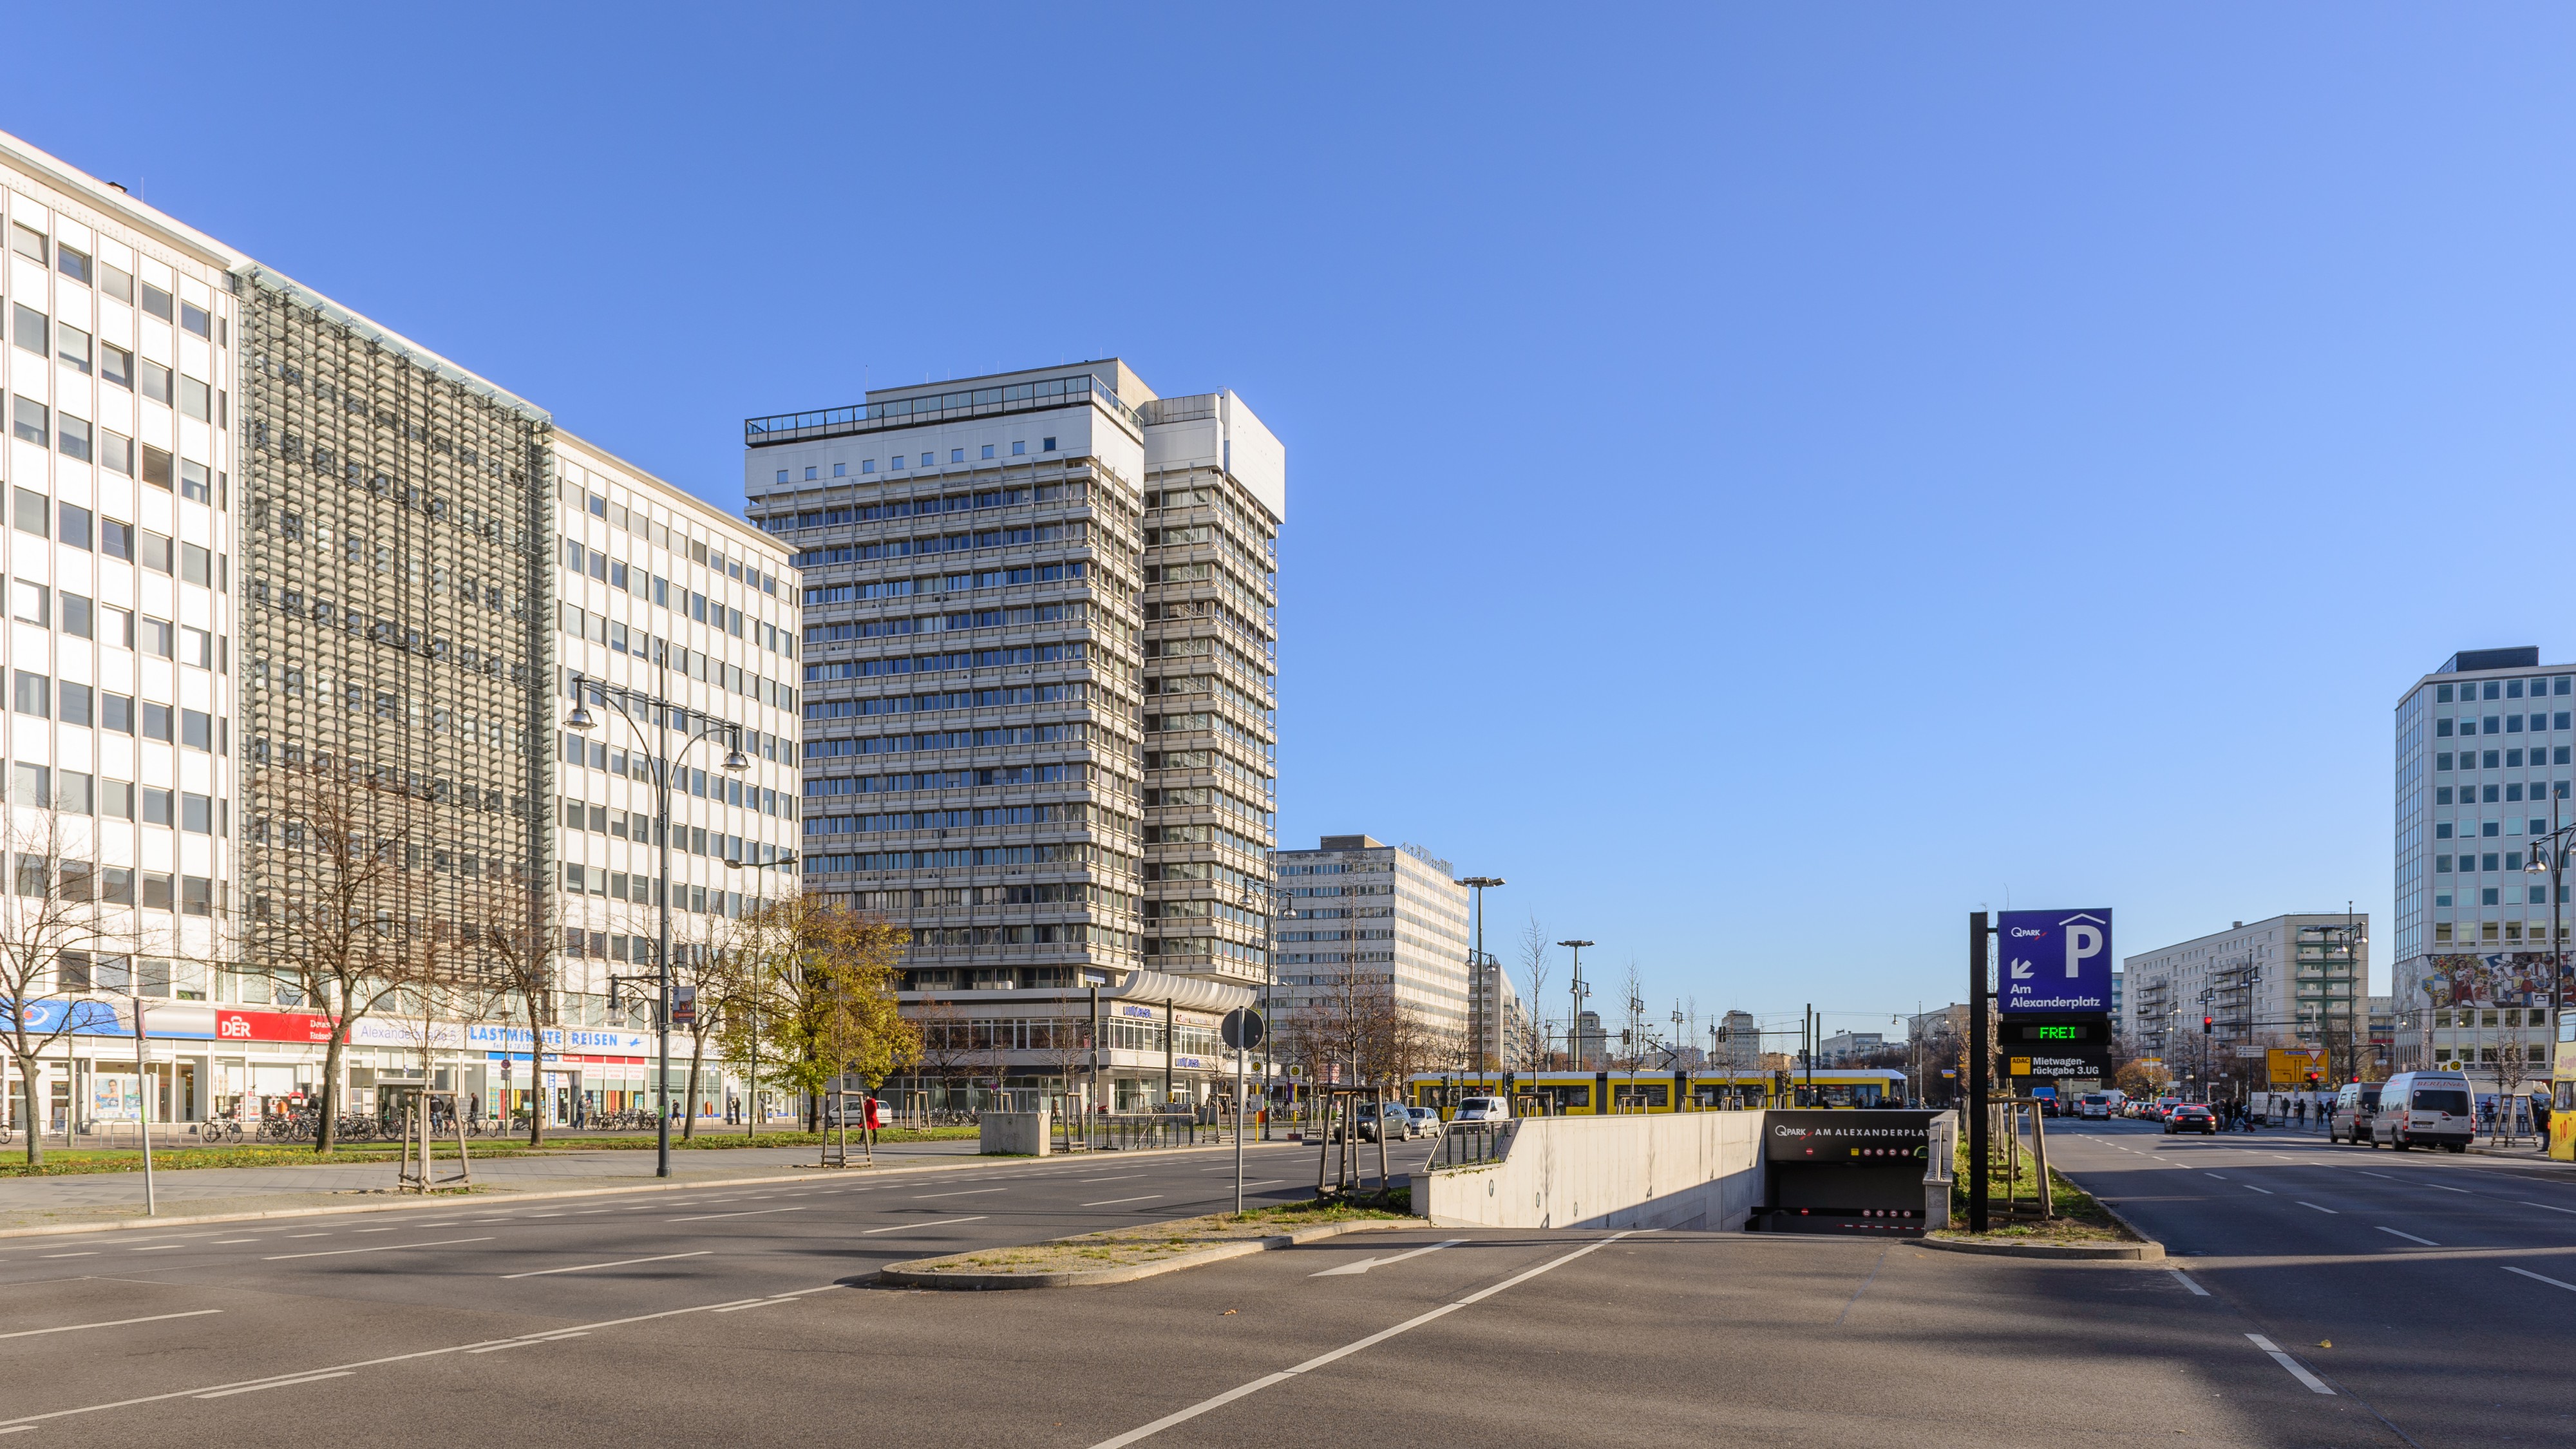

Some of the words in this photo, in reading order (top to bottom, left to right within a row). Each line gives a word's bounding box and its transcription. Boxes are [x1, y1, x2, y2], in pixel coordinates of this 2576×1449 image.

[2066, 925, 2103, 978] P
[2010, 984, 2031, 994] Am
[2010, 996, 2101, 1009] Alexanderplatz
[222, 1019, 251, 1037] DER
[361, 1026, 447, 1040] Alexanderstaße
[451, 1030, 457, 1041] 5
[2040, 1027, 2076, 1039] FREI
[571, 1032, 618, 1046] REISEN
[2032, 1057, 2085, 1066] Mietwagen-
[2032, 1066, 2075, 1076] rückgabe
[2077, 1066, 2099, 1075] 3.UG
